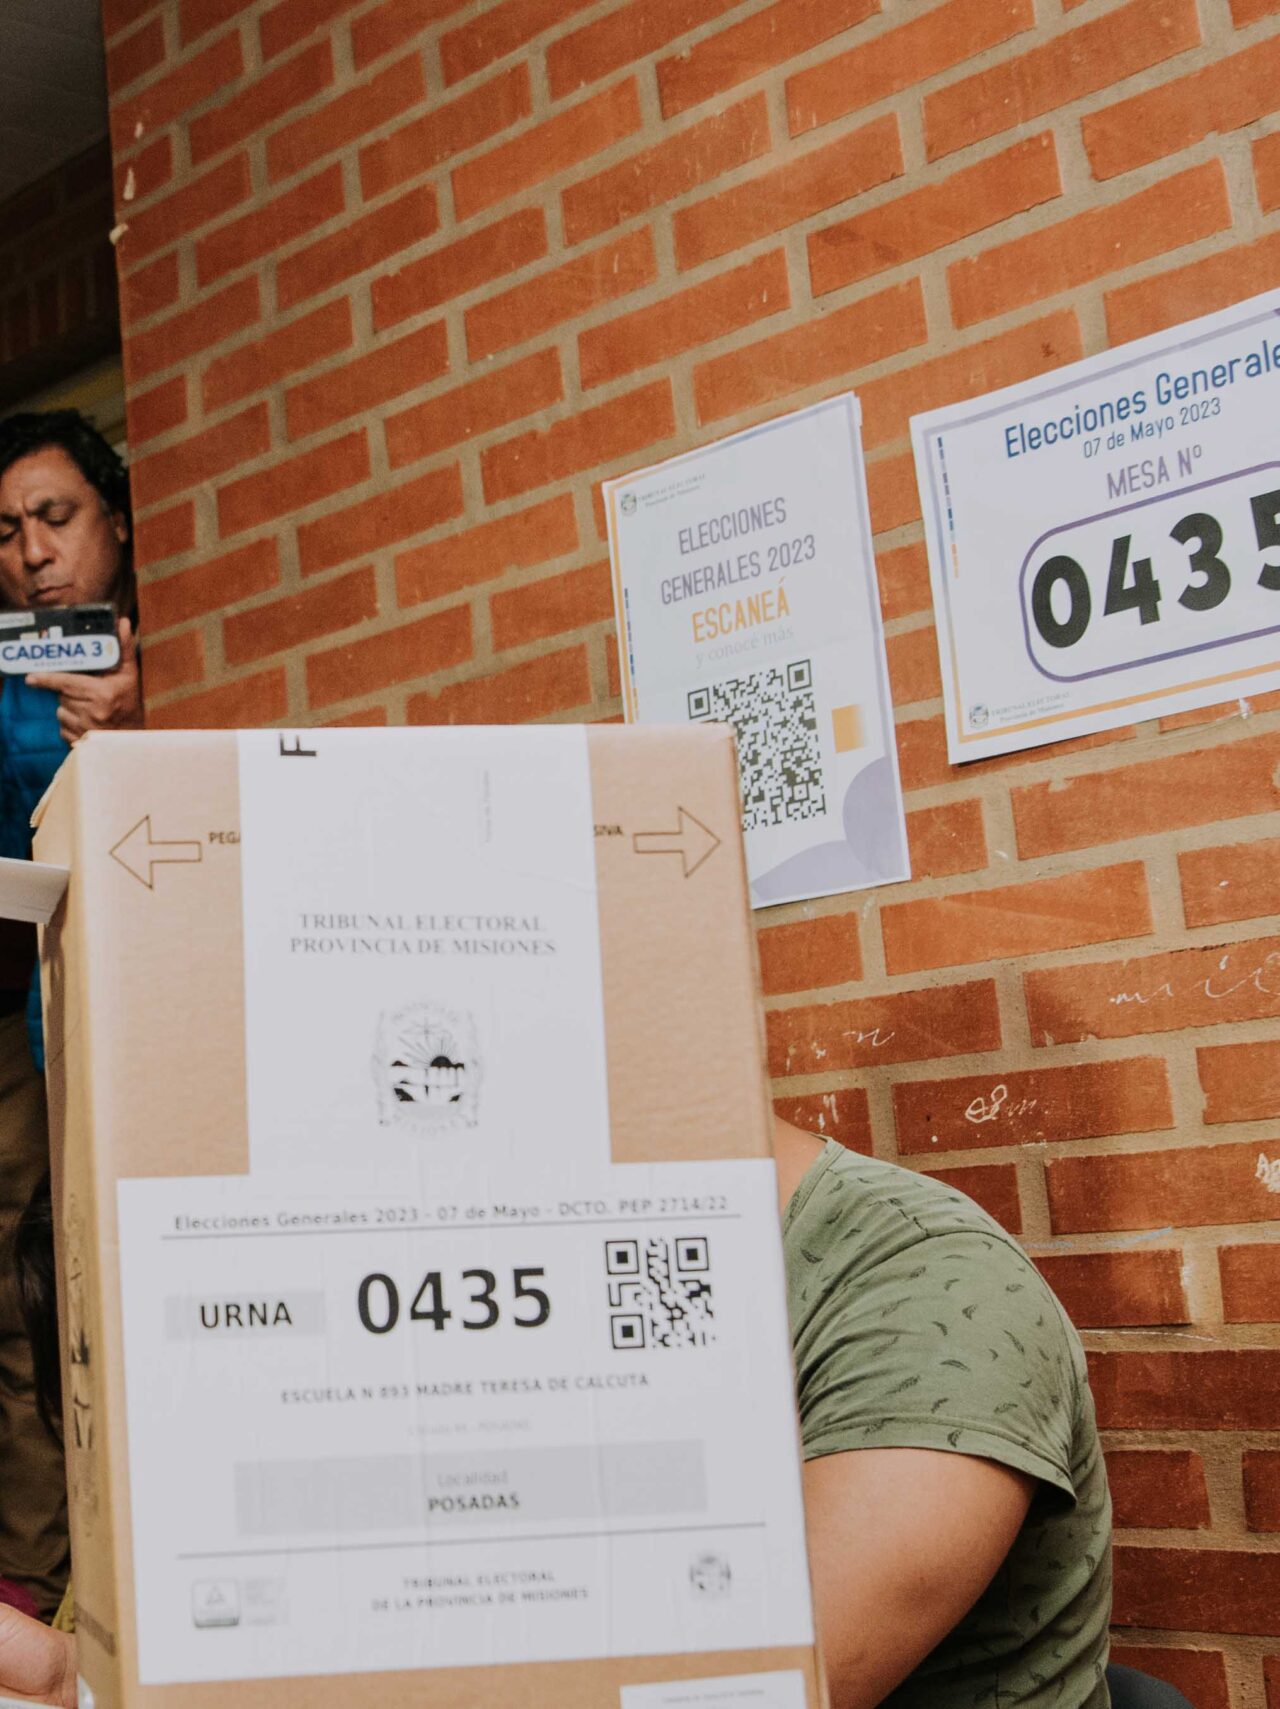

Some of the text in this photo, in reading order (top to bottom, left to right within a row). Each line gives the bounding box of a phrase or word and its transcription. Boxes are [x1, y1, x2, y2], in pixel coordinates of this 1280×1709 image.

[1004, 391, 1147, 458] Elecciones
[1083, 396, 1222, 458] 07 de Mayo 2023
[1106, 456, 1170, 499] MESA
[678, 497, 787, 555] ELECCIONES
[661, 534, 817, 605] GENERALES 2023
[691, 576, 790, 643] ESCANEÁ
[2, 641, 103, 661] CADENA 3
[299, 913, 546, 932] TRIBUNAL ELECTORAL
[290, 938, 557, 956] PROVINCIA DE MISIONES
[174, 1214, 270, 1231] Elecciones
[277, 1209, 368, 1227] Generales
[376, 1206, 419, 1224] 2023
[436, 1204, 459, 1221] 07
[466, 1206, 486, 1220] de
[493, 1204, 541, 1223] Mayo
[620, 1197, 652, 1214] PEP
[200, 1267, 551, 1334] URNA 0435
[280, 1388, 356, 1405] ESCUELA
[416, 1381, 473, 1398] MADRE
[480, 1378, 543, 1395] TERESA
[547, 1376, 569, 1392] DE
[574, 1373, 650, 1391] CALCUTA
[427, 1493, 521, 1512] POSADAS
